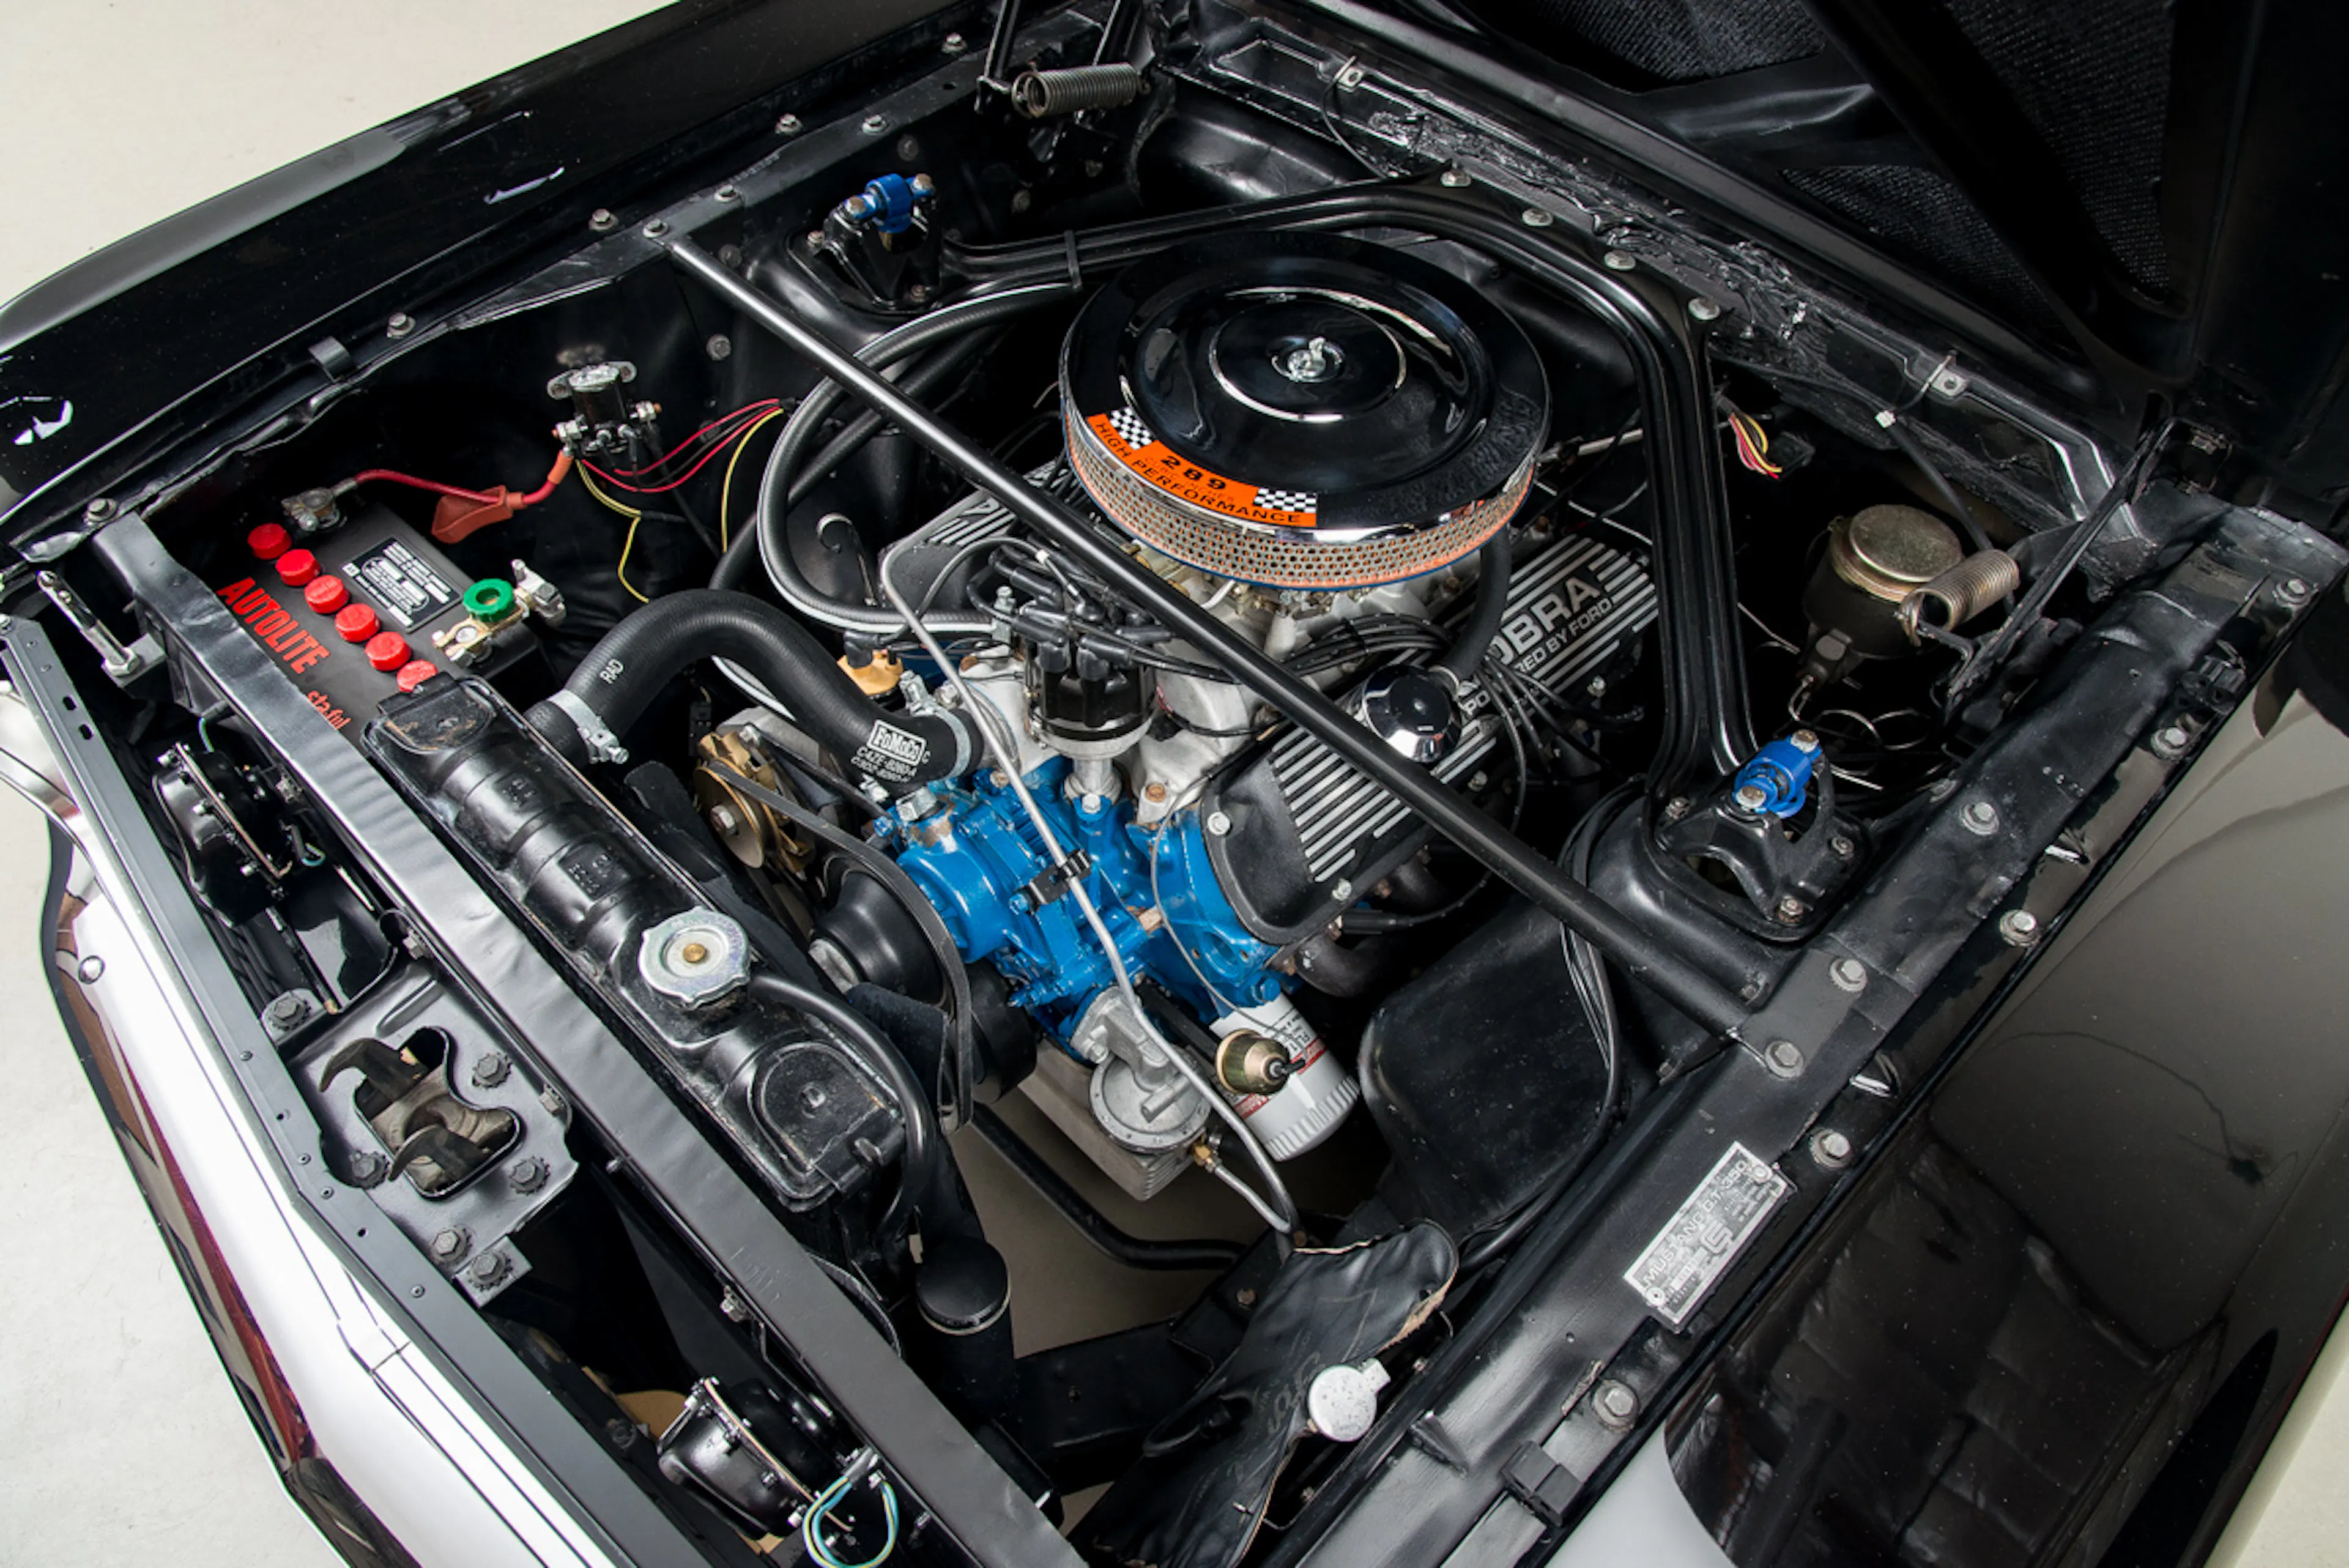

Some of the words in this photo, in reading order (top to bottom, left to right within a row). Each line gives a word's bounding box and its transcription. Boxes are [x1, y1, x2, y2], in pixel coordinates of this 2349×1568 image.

[1095, 421, 1132, 458] HIGH
[1132, 460, 1302, 524] PERFORMANCE
[1160, 455, 1227, 491] 289
[217, 577, 330, 674] AUTOLITE
[1547, 628, 1569, 653] BY
[1569, 597, 1613, 635] FORD
[599, 659, 625, 684] RAD
[1642, 1213, 1703, 1285] MUSTANG
[1723, 1159, 1748, 1189] 350
